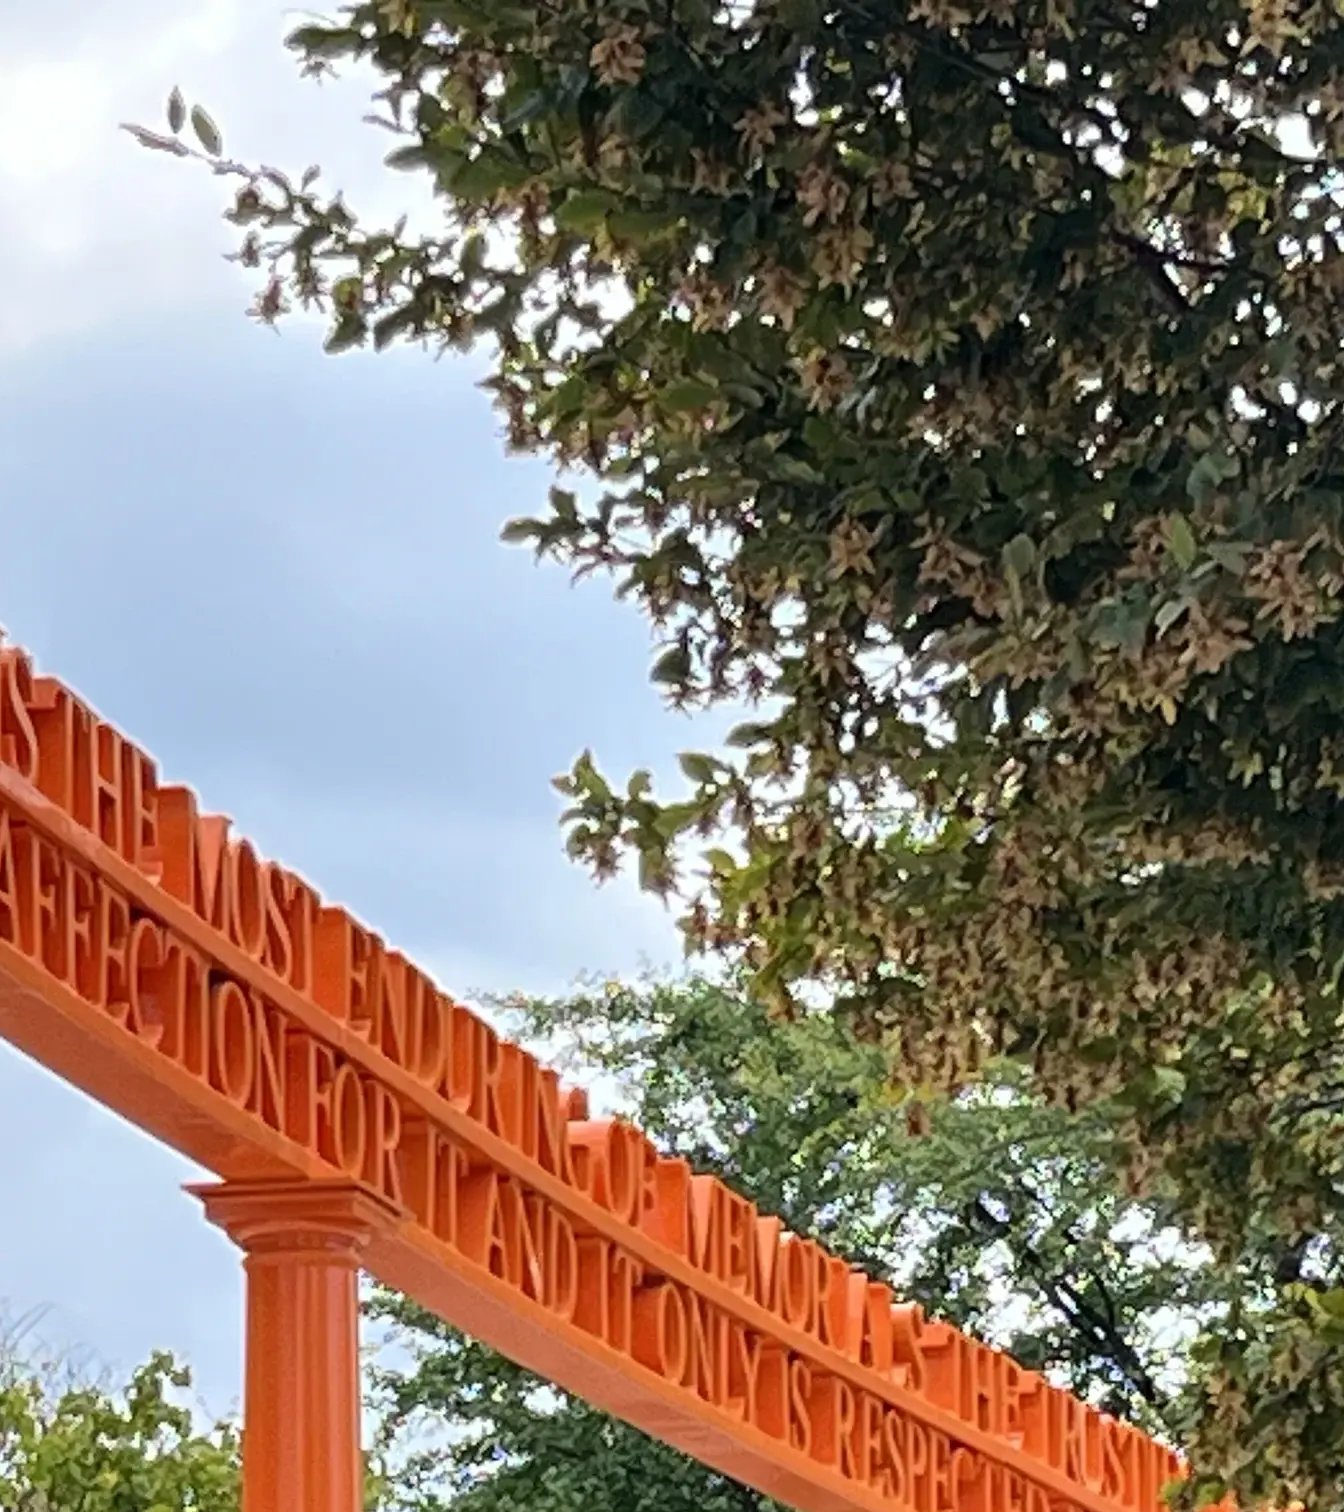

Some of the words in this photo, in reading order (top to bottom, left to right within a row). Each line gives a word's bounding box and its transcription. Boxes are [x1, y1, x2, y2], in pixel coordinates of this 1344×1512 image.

[50, 677, 164, 888] THE
[186, 786, 324, 1000] MOST
[342, 906, 594, 1200] ENDURING
[607, 1117, 660, 1230] OF
[945, 1325, 1025, 1450] THE
[307, 1032, 404, 1212] FOR
[426, 1119, 471, 1245] IT
[485, 1168, 578, 1322] AND
[600, 1237, 645, 1360] IT
[659, 1281, 763, 1425] ONLY
[782, 1348, 813, 1458] IS
